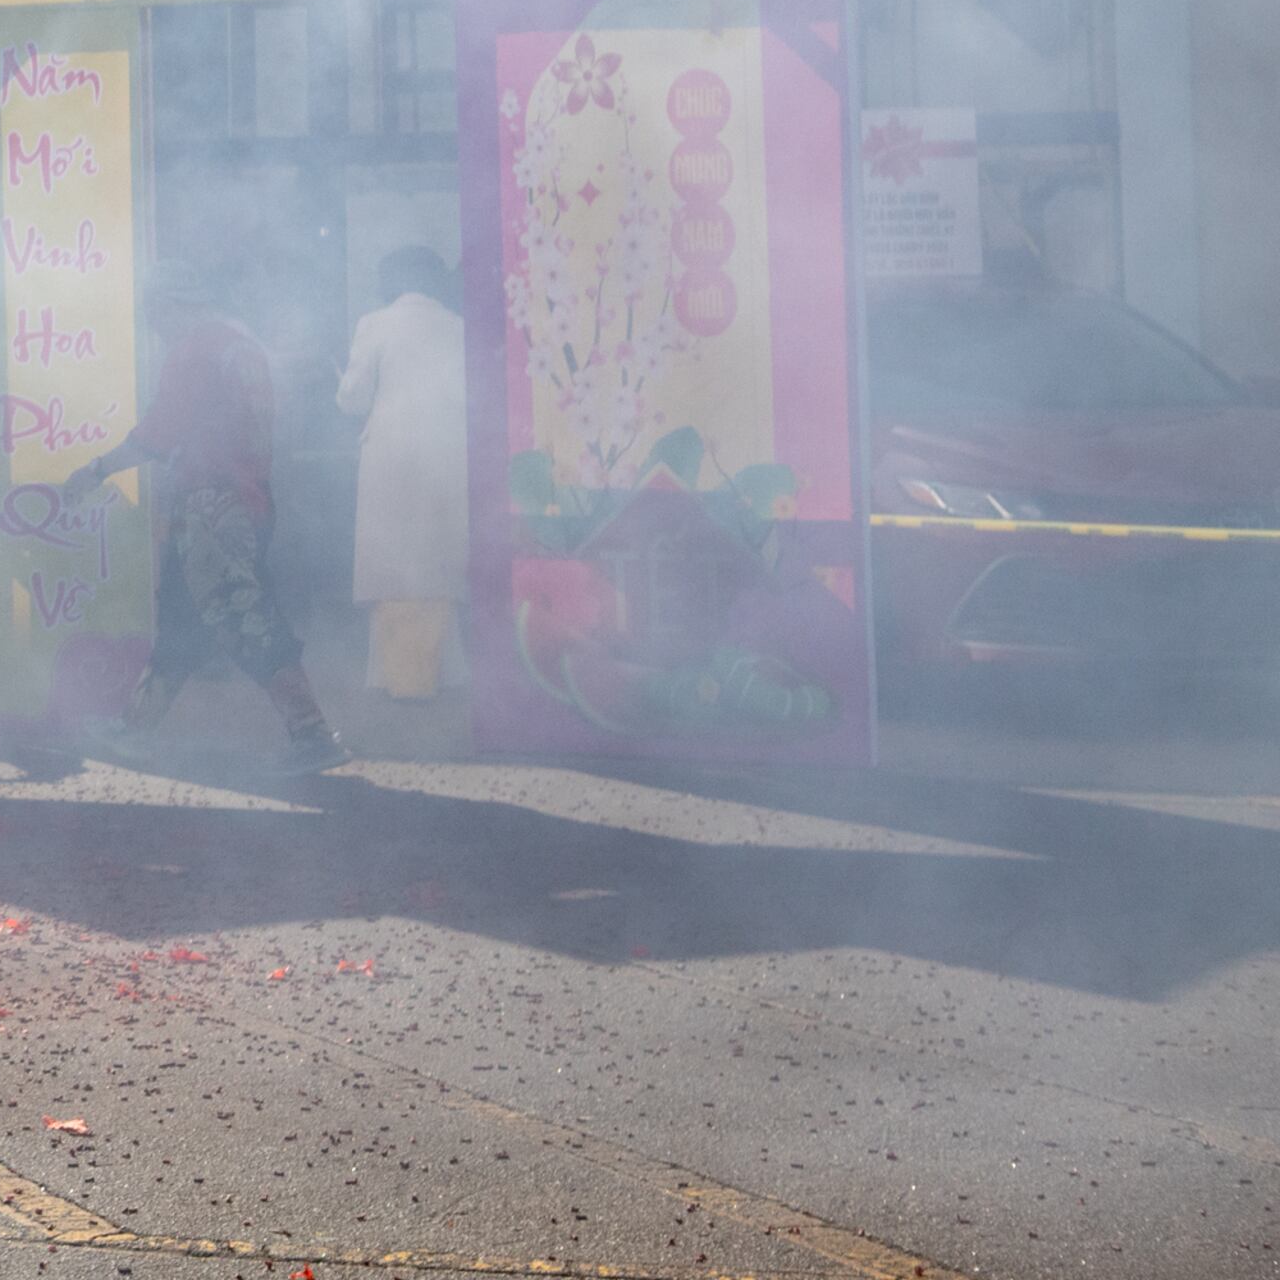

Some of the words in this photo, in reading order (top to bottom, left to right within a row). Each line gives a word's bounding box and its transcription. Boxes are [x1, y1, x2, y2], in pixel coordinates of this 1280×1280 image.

[1, 42, 101, 106] Năm
[8, 131, 98, 194] Mới
[2, 219, 108, 273] Vinh
[13, 306, 96, 368] Hoa
